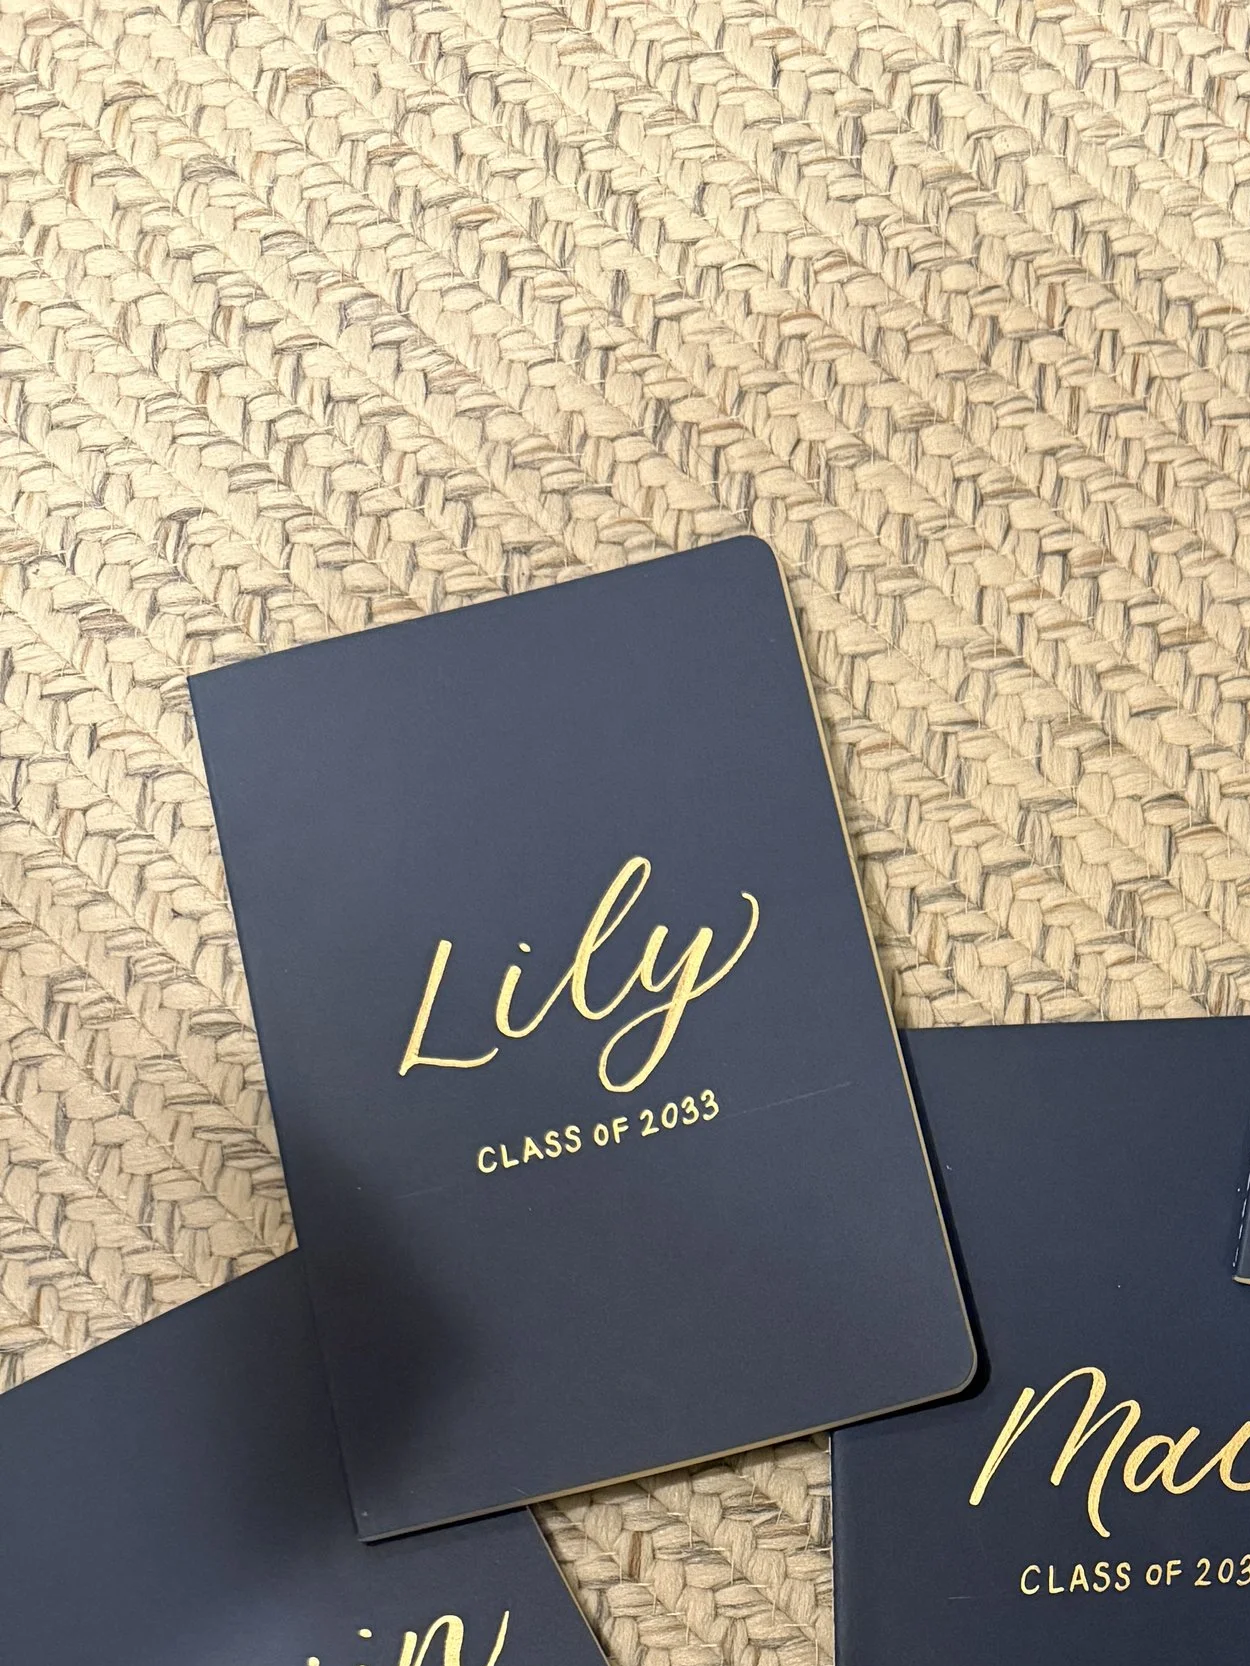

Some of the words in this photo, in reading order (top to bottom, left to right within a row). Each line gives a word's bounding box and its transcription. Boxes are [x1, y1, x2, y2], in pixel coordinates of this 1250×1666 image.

[398, 856, 760, 1094] Lily
[475, 1125, 583, 1176] CLASS
[591, 1113, 630, 1148] OF
[638, 1088, 720, 1138] 2033
[1018, 1559, 1131, 1596] CLASS
[1144, 1558, 1184, 1588] OF
